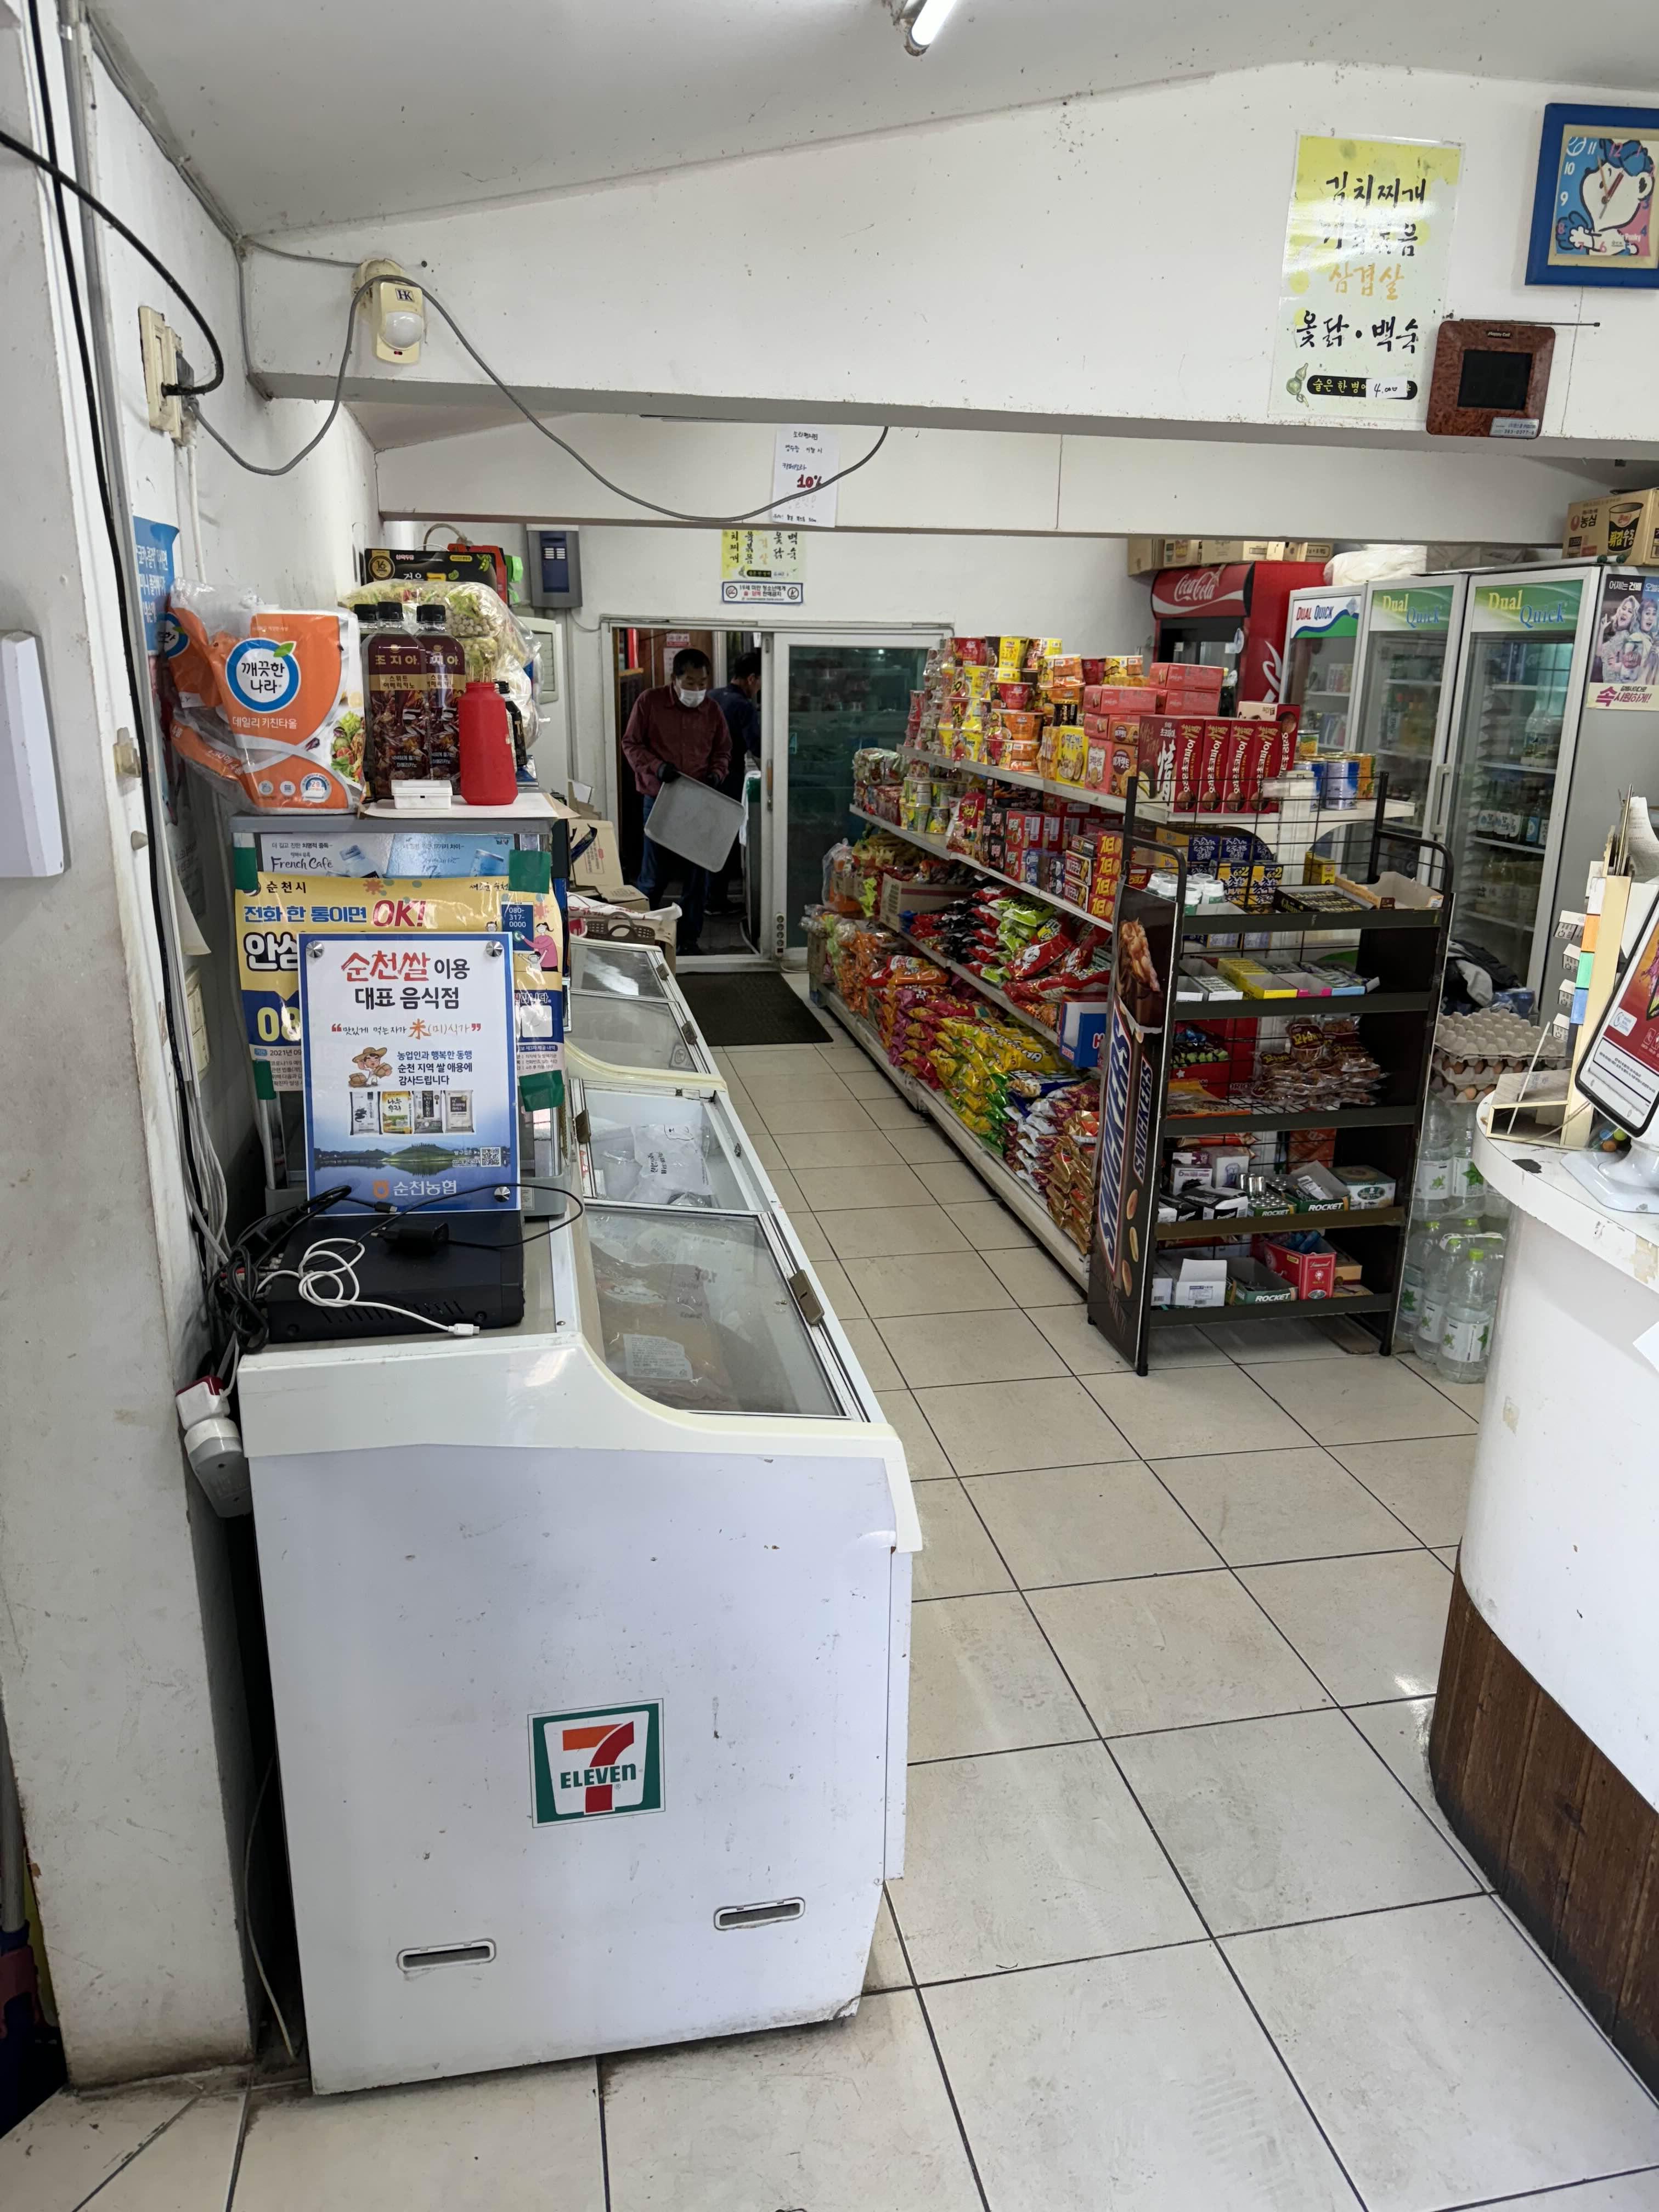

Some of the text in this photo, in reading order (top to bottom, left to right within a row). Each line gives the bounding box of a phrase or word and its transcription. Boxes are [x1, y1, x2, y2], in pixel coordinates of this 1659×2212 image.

[1564, 162, 1575, 176] 10
[1325, 171, 1426, 209] 김치찌개
[1560, 191, 1568, 206] 9
[1328, 263, 1405, 301] 삼겹살
[397, 289, 414, 301] HK
[1312, 379, 1334, 393] 술은
[1338, 380, 1347, 393] 한
[797, 474, 823, 488] 10%
[1580, 514, 1598, 528] 농심
[1609, 580, 1628, 590] 어제는
[1382, 594, 1409, 613] Dual
[1487, 590, 1522, 611] Dual
[1296, 605, 1334, 620] DUAL QUICK
[1405, 607, 1440, 629] Quick
[1520, 604, 1566, 629] Quick
[375, 654, 417, 665] 조지아
[241, 660, 285, 678] 깨끗한
[250, 680, 278, 694] 나라
[232, 716, 298, 730] 데일리 키친타올
[270, 856, 308, 873] French
[266, 881, 307, 894] 순천시
[243, 899, 428, 928] 전화 한 통이면 OK!
[341, 950, 470, 982] 순천쌀 이용
[354, 987, 460, 1010] 대표 음식점
[397, 1051, 472, 1060] 농업인과 행복한 동행
[397, 1063, 472, 1073] 순천 지역 쌀 애용에
[398, 1075, 450, 1086] 감사드립니다
[1134, 1058, 1152, 1185] SNICKERS
[393, 1180, 457, 1197] 순천농협
[1262, 1209, 1290, 1217] ROCKET
[1308, 1202, 1344, 1212] ROCKET
[1255, 1292, 1291, 1303] ROCKET
[562, 1721, 634, 1813] 7
